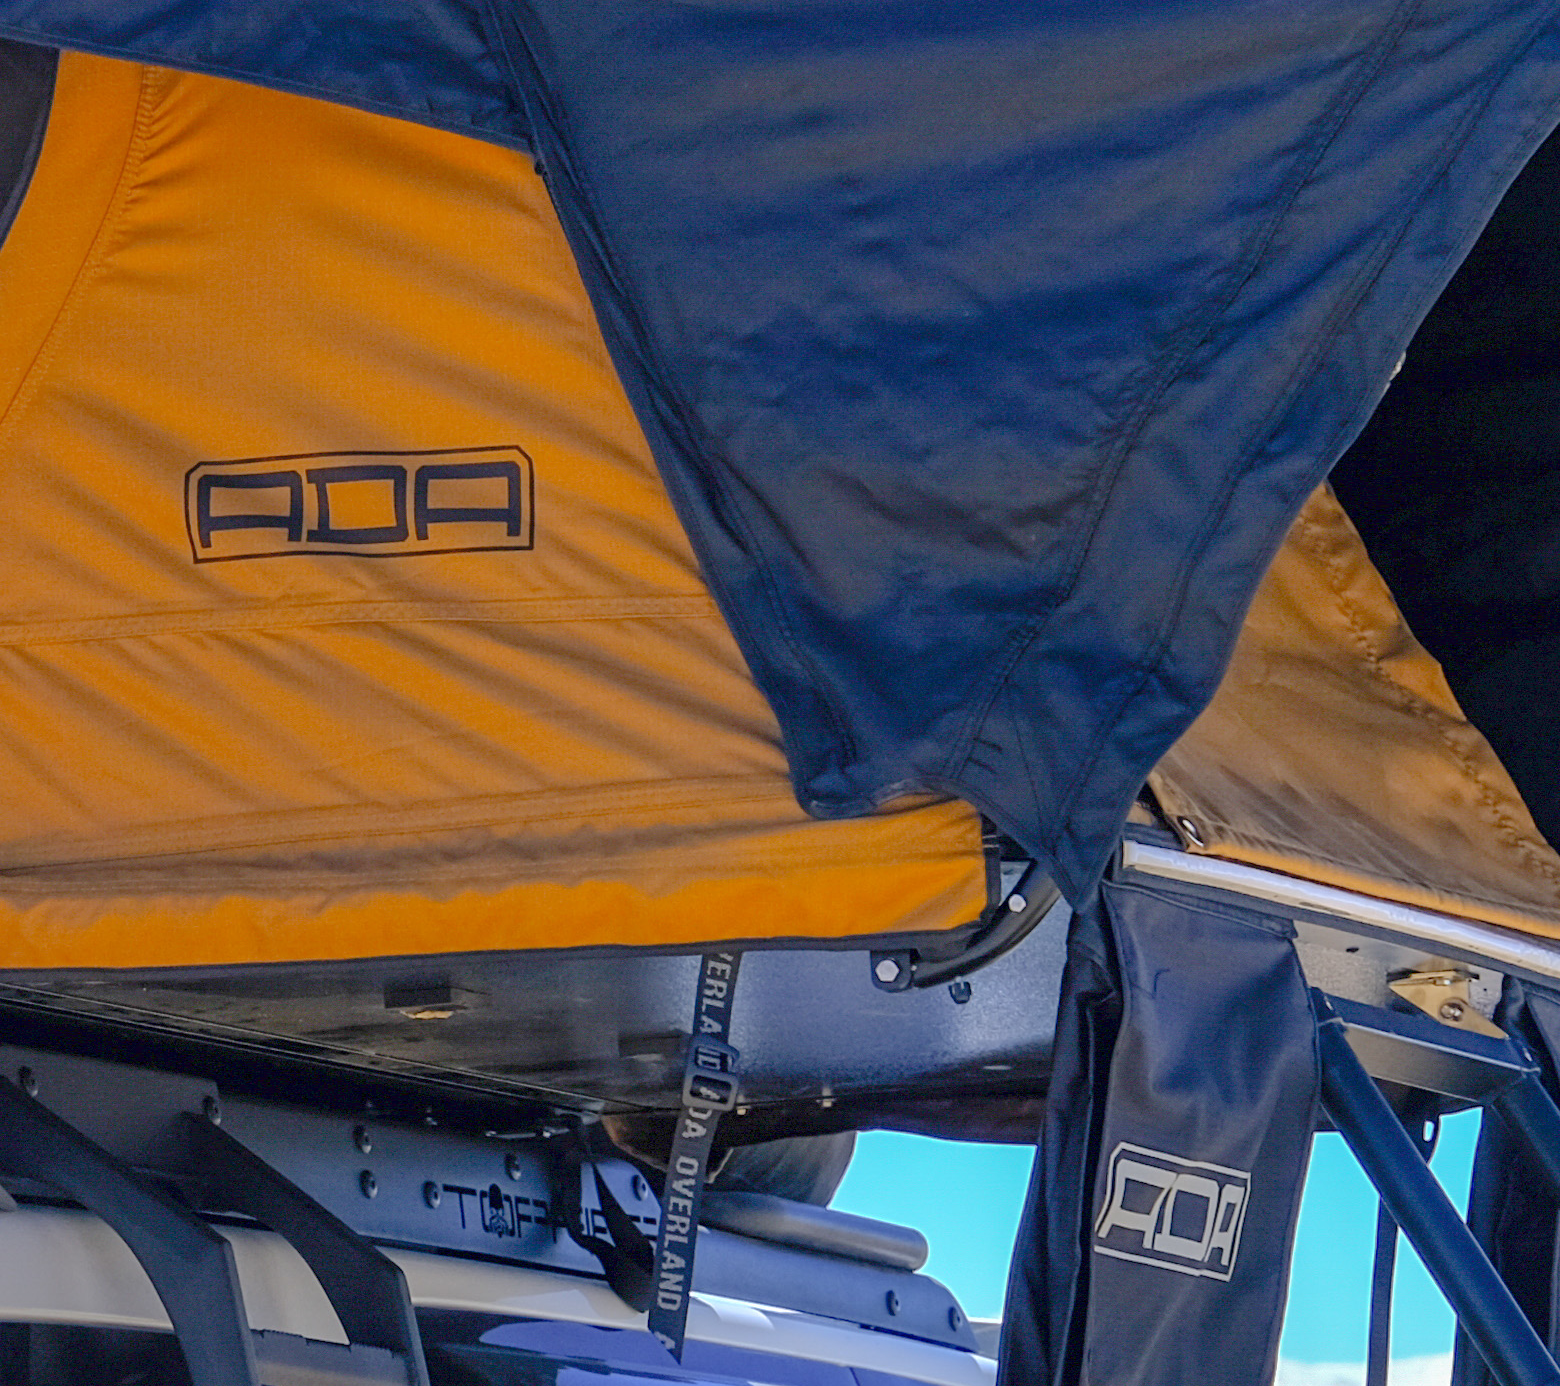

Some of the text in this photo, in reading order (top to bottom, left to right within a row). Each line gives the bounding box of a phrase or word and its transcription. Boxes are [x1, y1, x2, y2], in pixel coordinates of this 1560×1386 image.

[197, 460, 522, 548] ADA
[656, 1155, 700, 1312] OVERLAND
[1097, 1157, 1247, 1268] ADA
